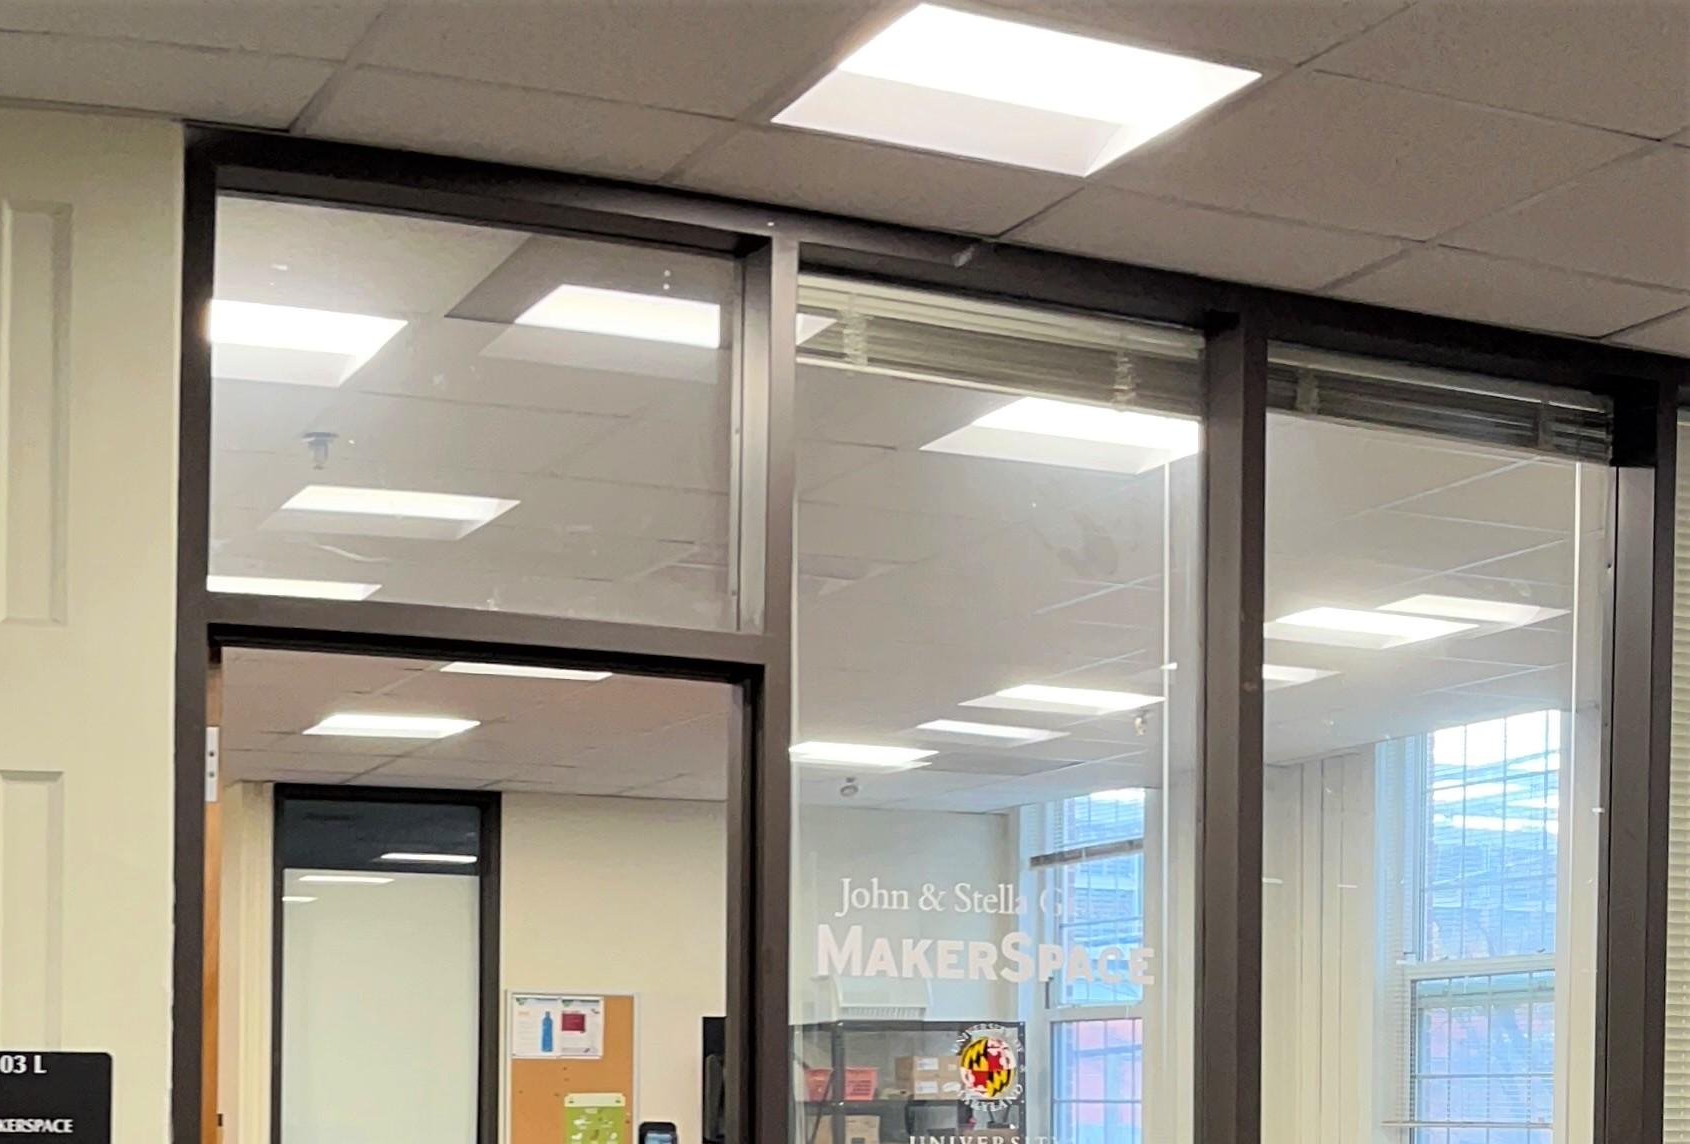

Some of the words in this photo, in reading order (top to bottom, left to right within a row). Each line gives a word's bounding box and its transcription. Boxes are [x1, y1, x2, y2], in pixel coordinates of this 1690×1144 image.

[834, 878, 910, 918] John
[918, 883, 946, 912] &
[953, 883, 1029, 916] Stella
[33, 1054, 48, 1074] L
